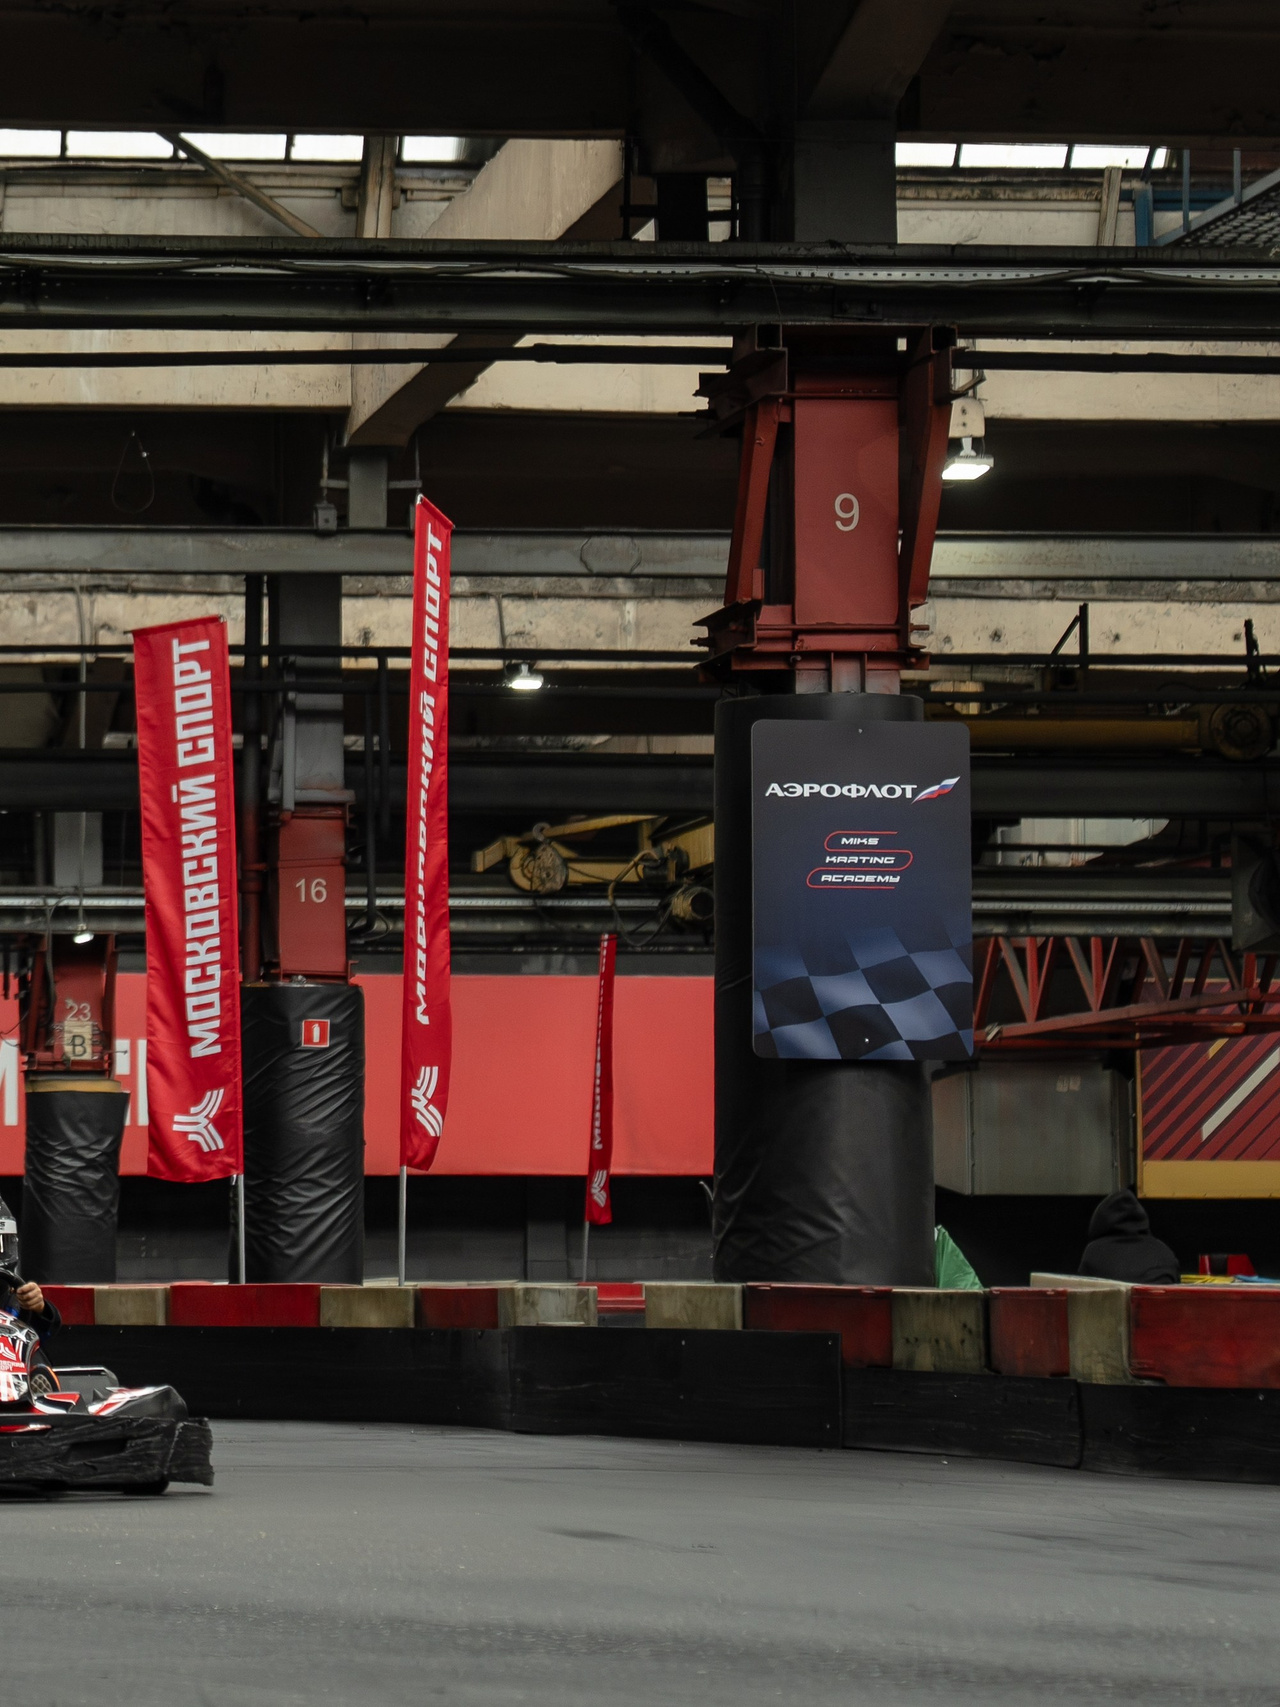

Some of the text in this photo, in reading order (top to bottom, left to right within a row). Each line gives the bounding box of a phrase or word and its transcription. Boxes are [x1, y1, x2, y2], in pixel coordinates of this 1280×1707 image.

[834, 493, 859, 531] 9
[422, 522, 442, 683] СПОРТ
[765, 782, 917, 799] АЭРОФЛОТ
[172, 637, 222, 1058] МОСКОВСКИЙ СПОРТ
[840, 837, 880, 846] MIKS
[825, 856, 896, 864] KARTING
[821, 874, 901, 883] ACADEMY
[295, 878, 327, 903] 16
[66, 1002, 91, 1021] 23
